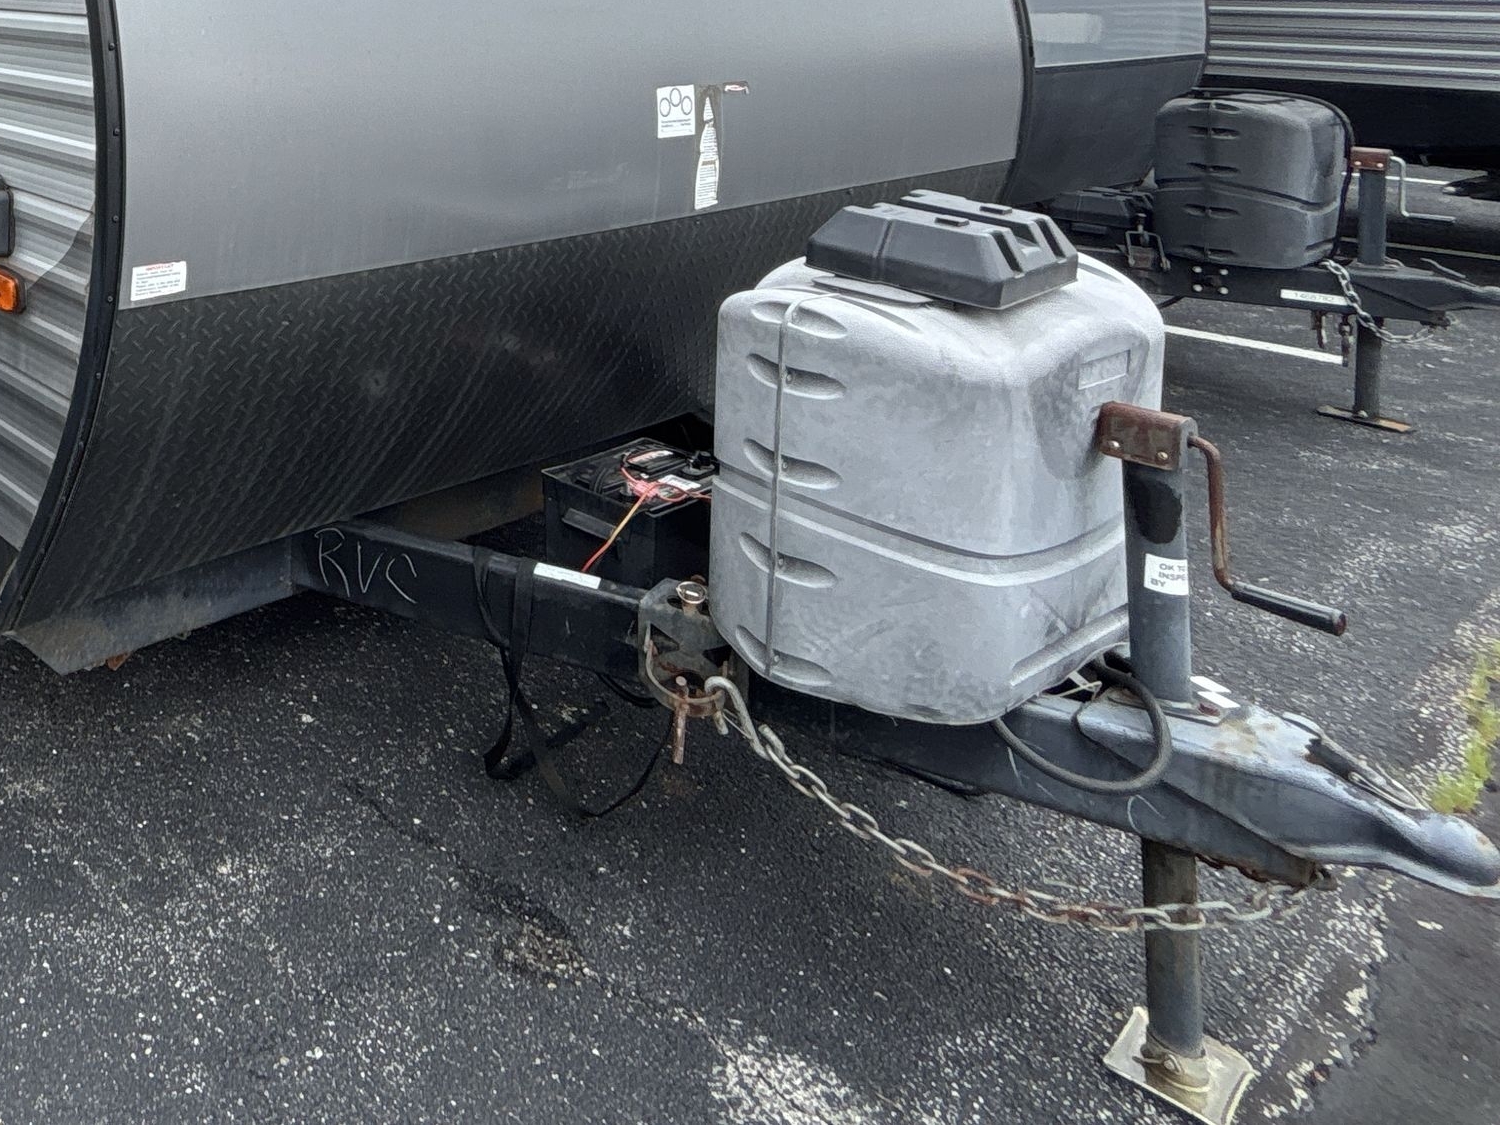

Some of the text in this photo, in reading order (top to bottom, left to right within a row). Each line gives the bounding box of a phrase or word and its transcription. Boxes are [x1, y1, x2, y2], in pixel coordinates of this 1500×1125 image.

[314, 528, 418, 604] RVC
[1159, 563, 1176, 572] OK
[1150, 578, 1167, 587] BY
